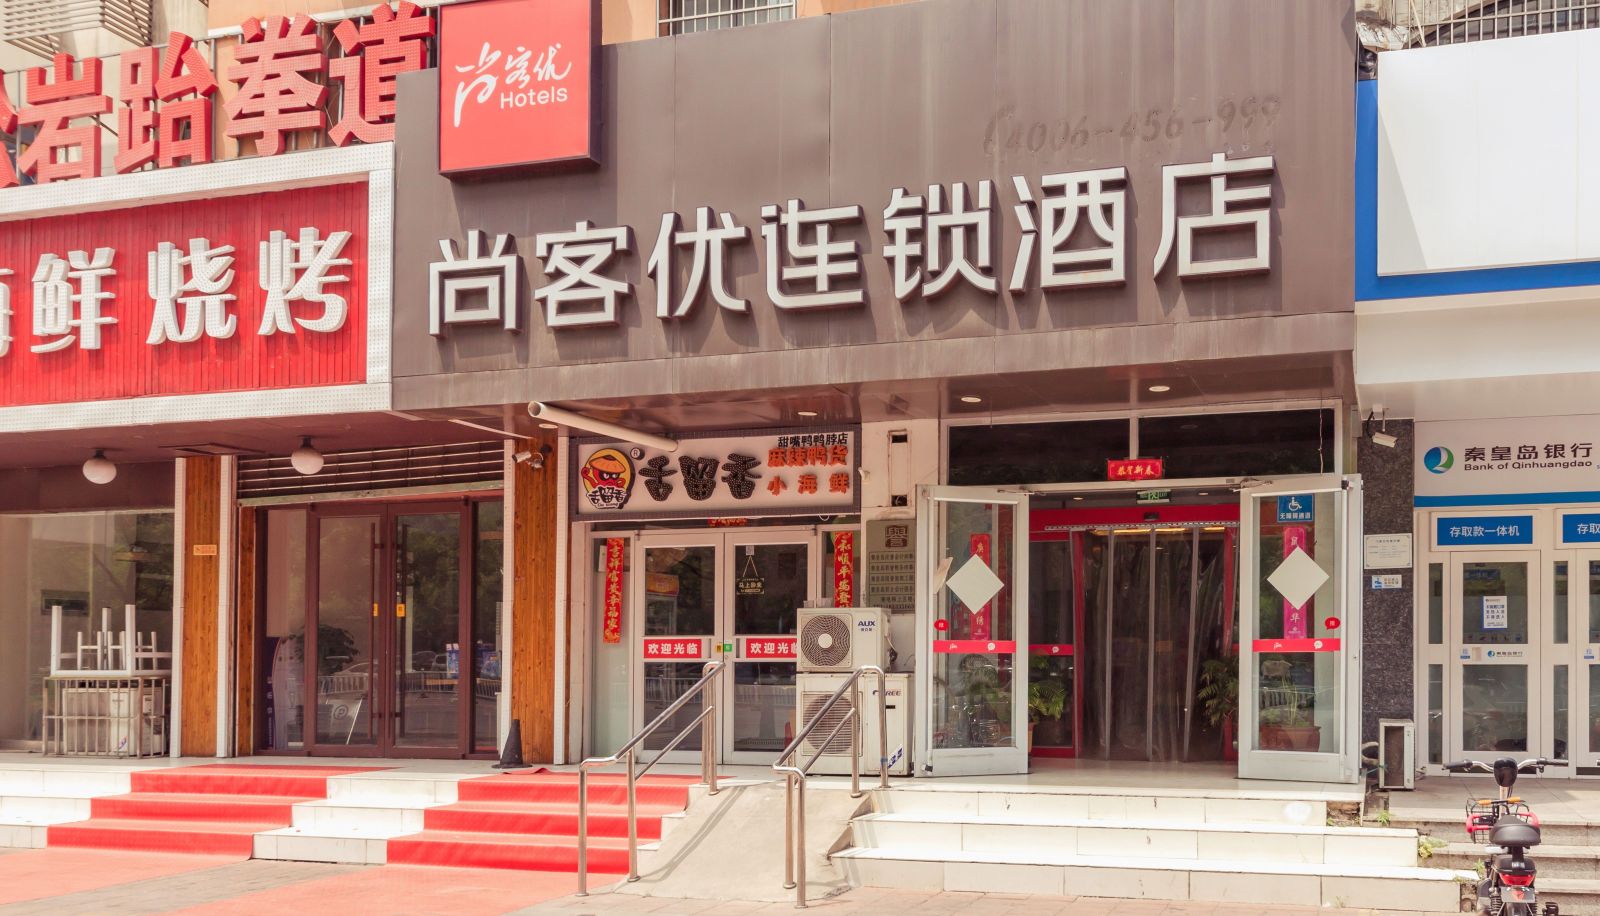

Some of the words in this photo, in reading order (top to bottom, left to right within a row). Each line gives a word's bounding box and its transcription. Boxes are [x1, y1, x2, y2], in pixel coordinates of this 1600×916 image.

[454, 41, 572, 128] 尚客优
[499, 85, 569, 110] Hotels
[429, 152, 1275, 337] 尚客优连锁酒店
[768, 446, 849, 467] 麻辣鸭货
[1464, 443, 1593, 462] 秦皇岛银行
[1464, 462, 1493, 471] Bank
[1497, 461, 1509, 470] of
[1512, 460, 1593, 472] Qinhuangdao
[639, 453, 762, 502] 舌留香
[767, 472, 850, 496] 小海鲜
[1450, 526, 1520, 538] 存取款一体机
[648, 643, 698, 655] 欢迎光临
